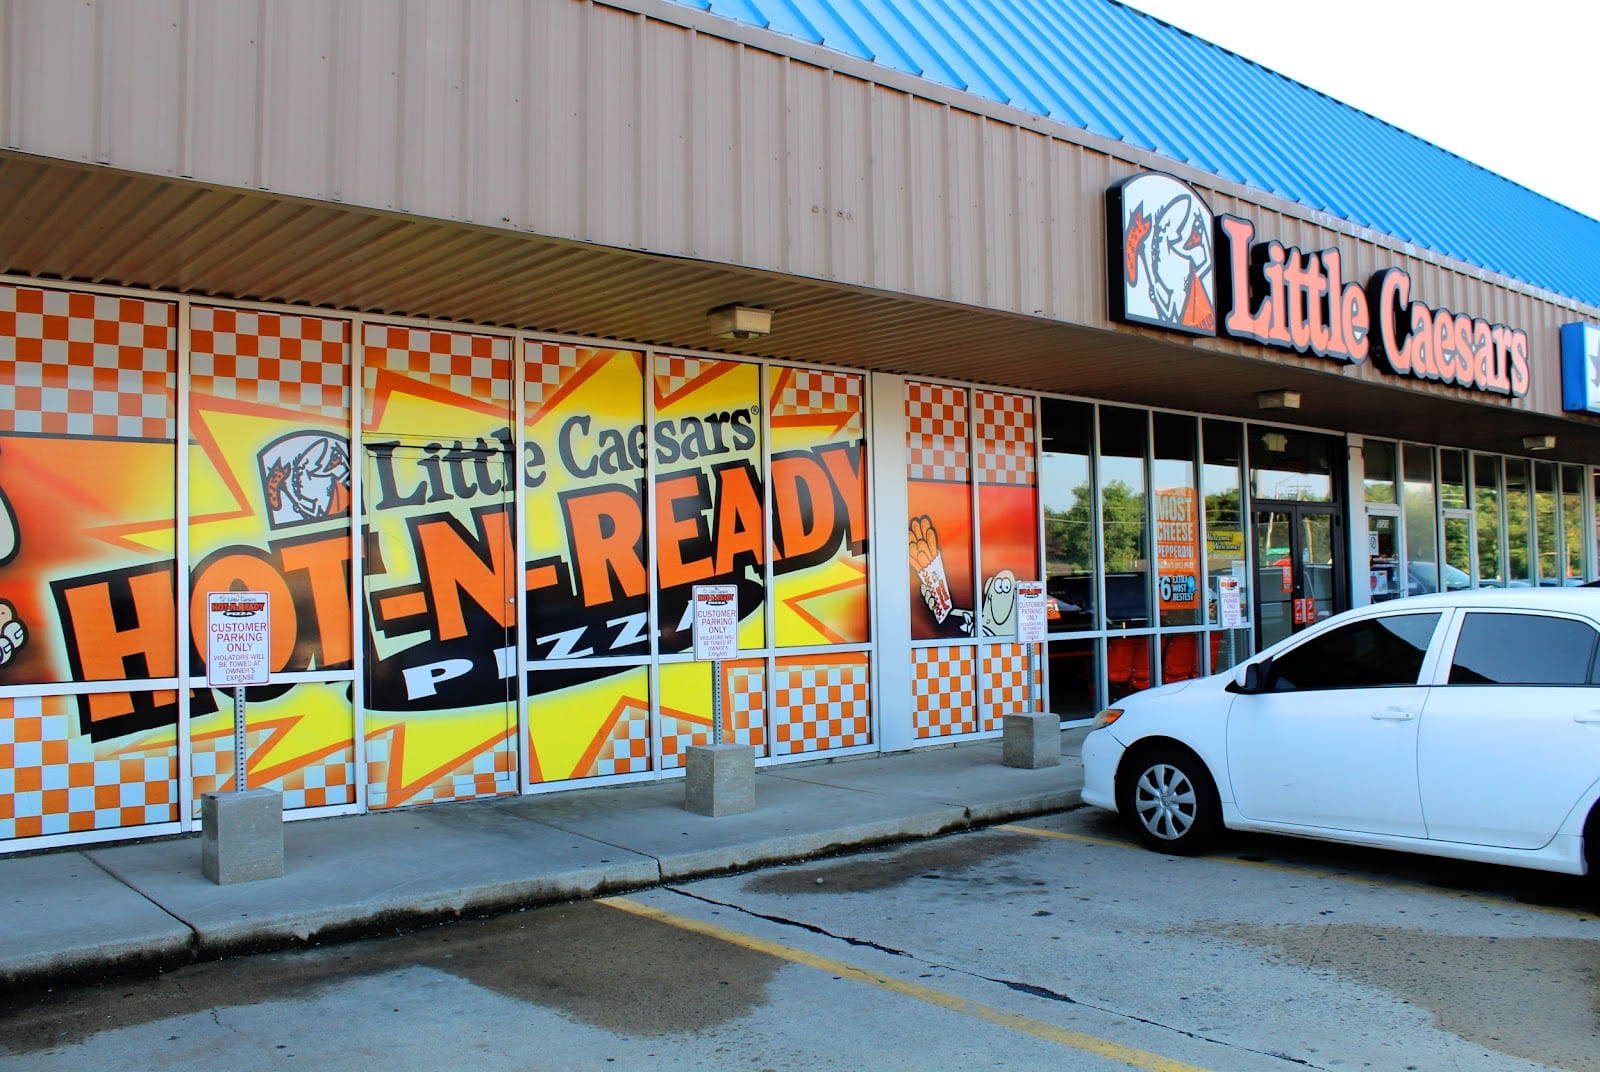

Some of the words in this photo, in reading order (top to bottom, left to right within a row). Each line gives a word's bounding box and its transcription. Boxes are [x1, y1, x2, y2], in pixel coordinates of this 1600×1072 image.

[1219, 212, 1370, 366] Little
[1378, 266, 1530, 399] Caesars
[367, 427, 546, 511] Little
[1155, 495, 1192, 521] MOST
[1157, 521, 1193, 541] CHEESE
[697, 610, 736, 618] CUSTOMER
[211, 622, 267, 632] CUSTOMER
[701, 618, 733, 626] PARKING
[708, 626, 727, 634] ONLY
[216, 633, 263, 642] PARKING
[226, 642, 253, 652] ONLY
[225, 667, 256, 675] OWNER'S
